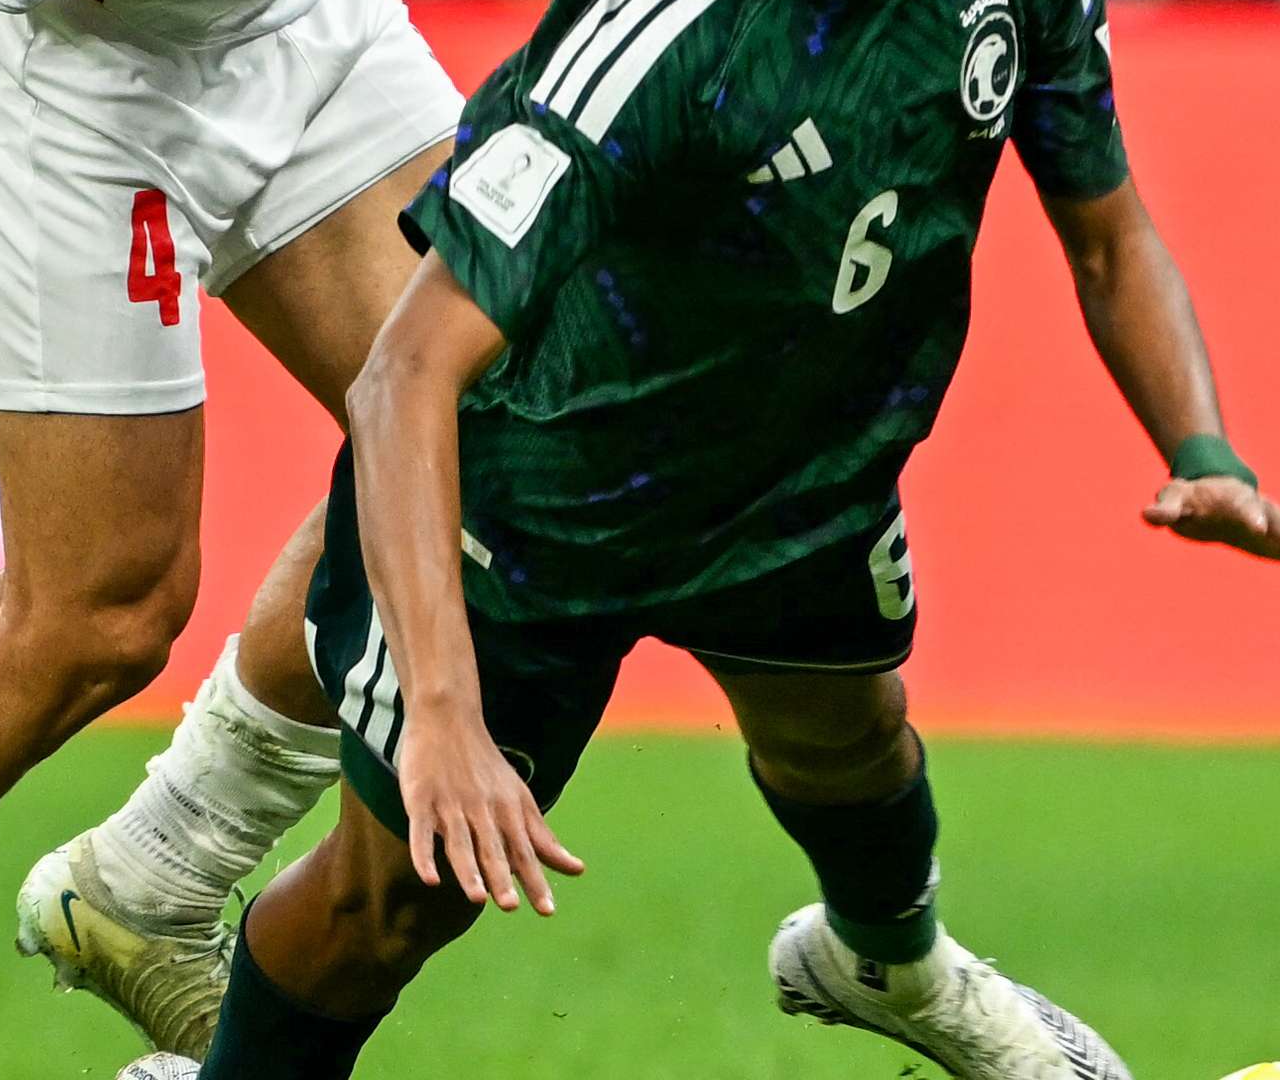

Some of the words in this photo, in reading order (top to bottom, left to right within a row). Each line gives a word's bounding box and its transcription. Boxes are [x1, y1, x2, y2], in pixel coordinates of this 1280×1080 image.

[127, 188, 181, 327] 4
[832, 188, 899, 315] 6
[868, 508, 915, 620] 6
